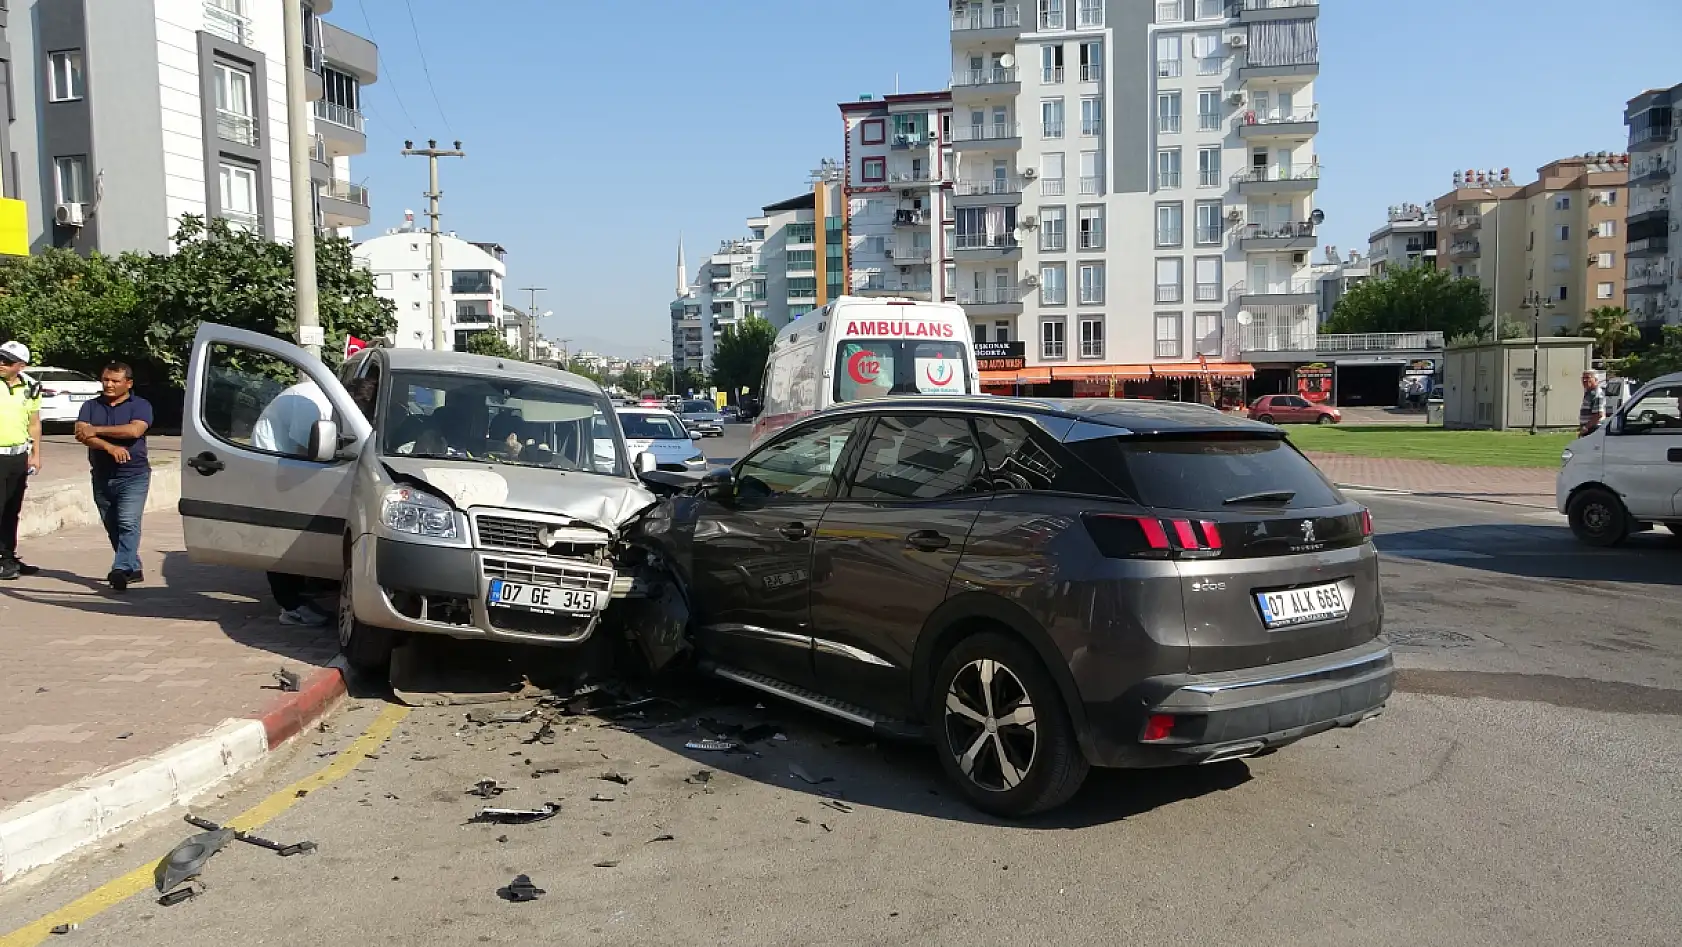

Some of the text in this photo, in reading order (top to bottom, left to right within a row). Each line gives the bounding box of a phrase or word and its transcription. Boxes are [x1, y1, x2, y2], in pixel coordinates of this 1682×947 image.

[846, 321, 954, 338] AMBULANS
[859, 361, 880, 374] 112
[989, 359, 1005, 368] AUTO
[502, 584, 522, 601] 07
[531, 588, 551, 605] GE
[564, 592, 592, 610] 345
[1269, 588, 1341, 617] 07 ALK 665
